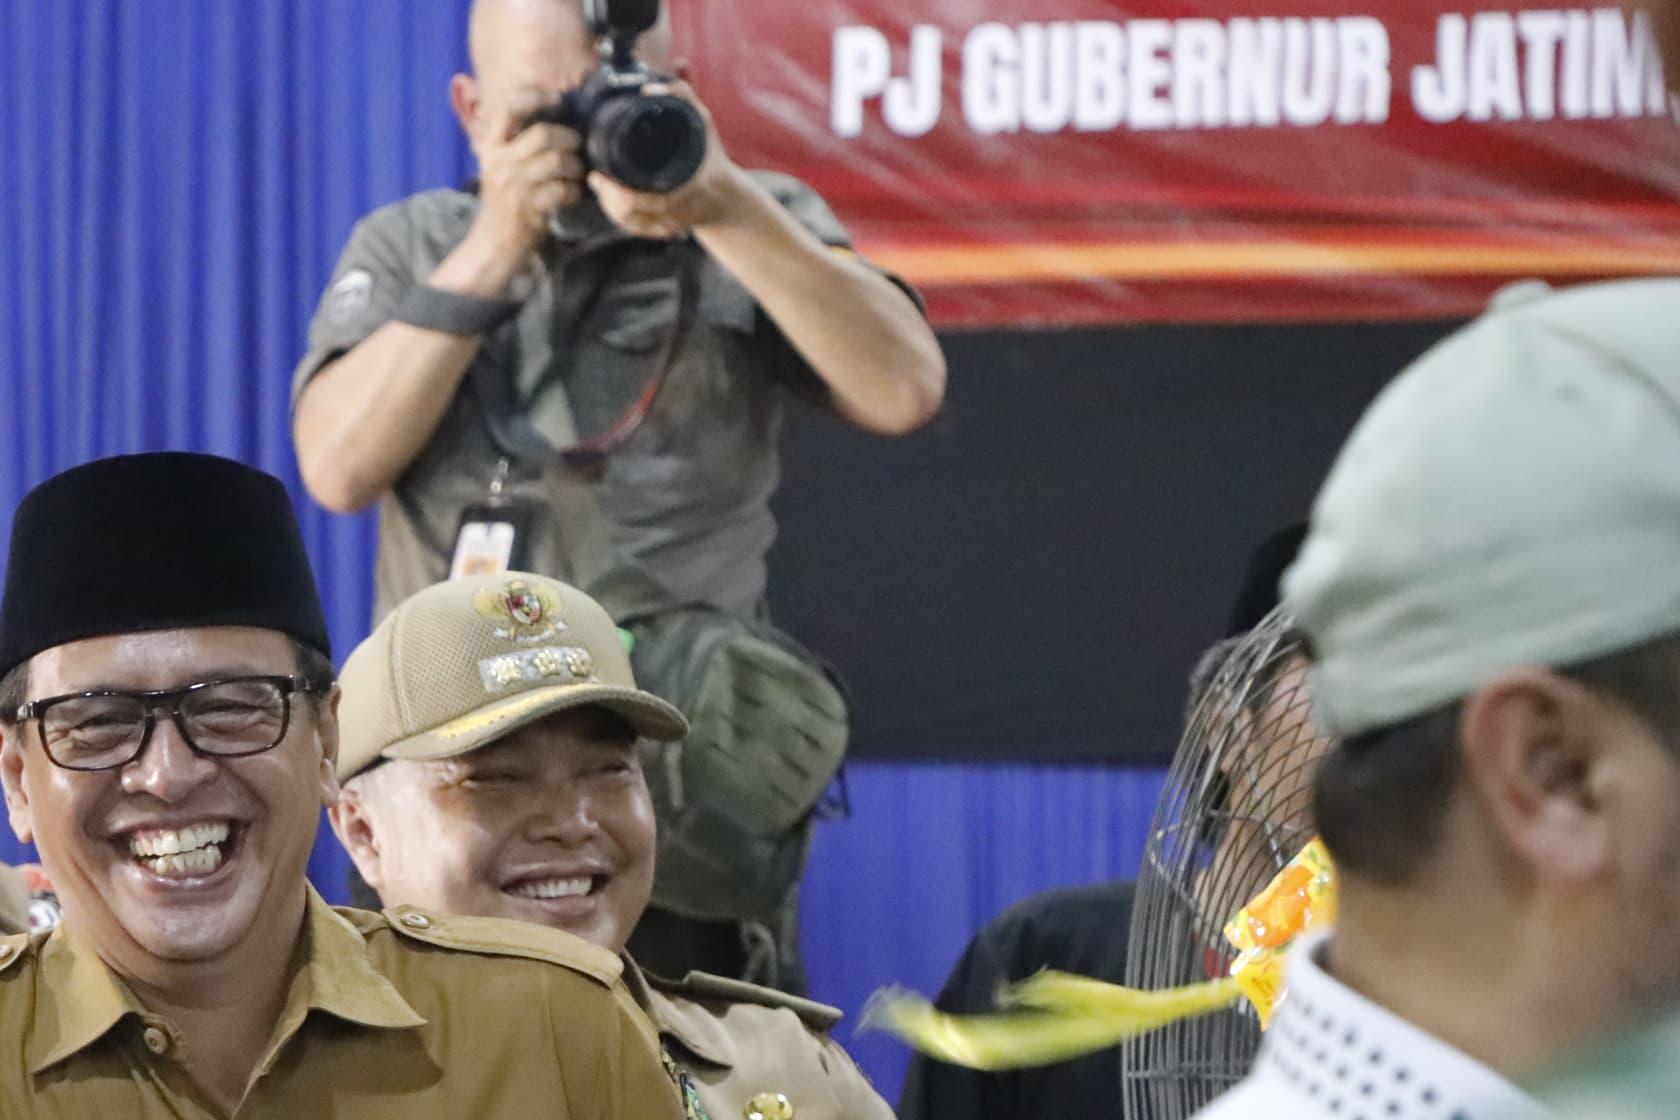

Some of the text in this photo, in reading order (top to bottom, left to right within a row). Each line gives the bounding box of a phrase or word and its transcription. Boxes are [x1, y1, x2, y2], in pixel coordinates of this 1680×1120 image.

[830, 7, 1666, 137] PJ GUBERNUR JATIM
